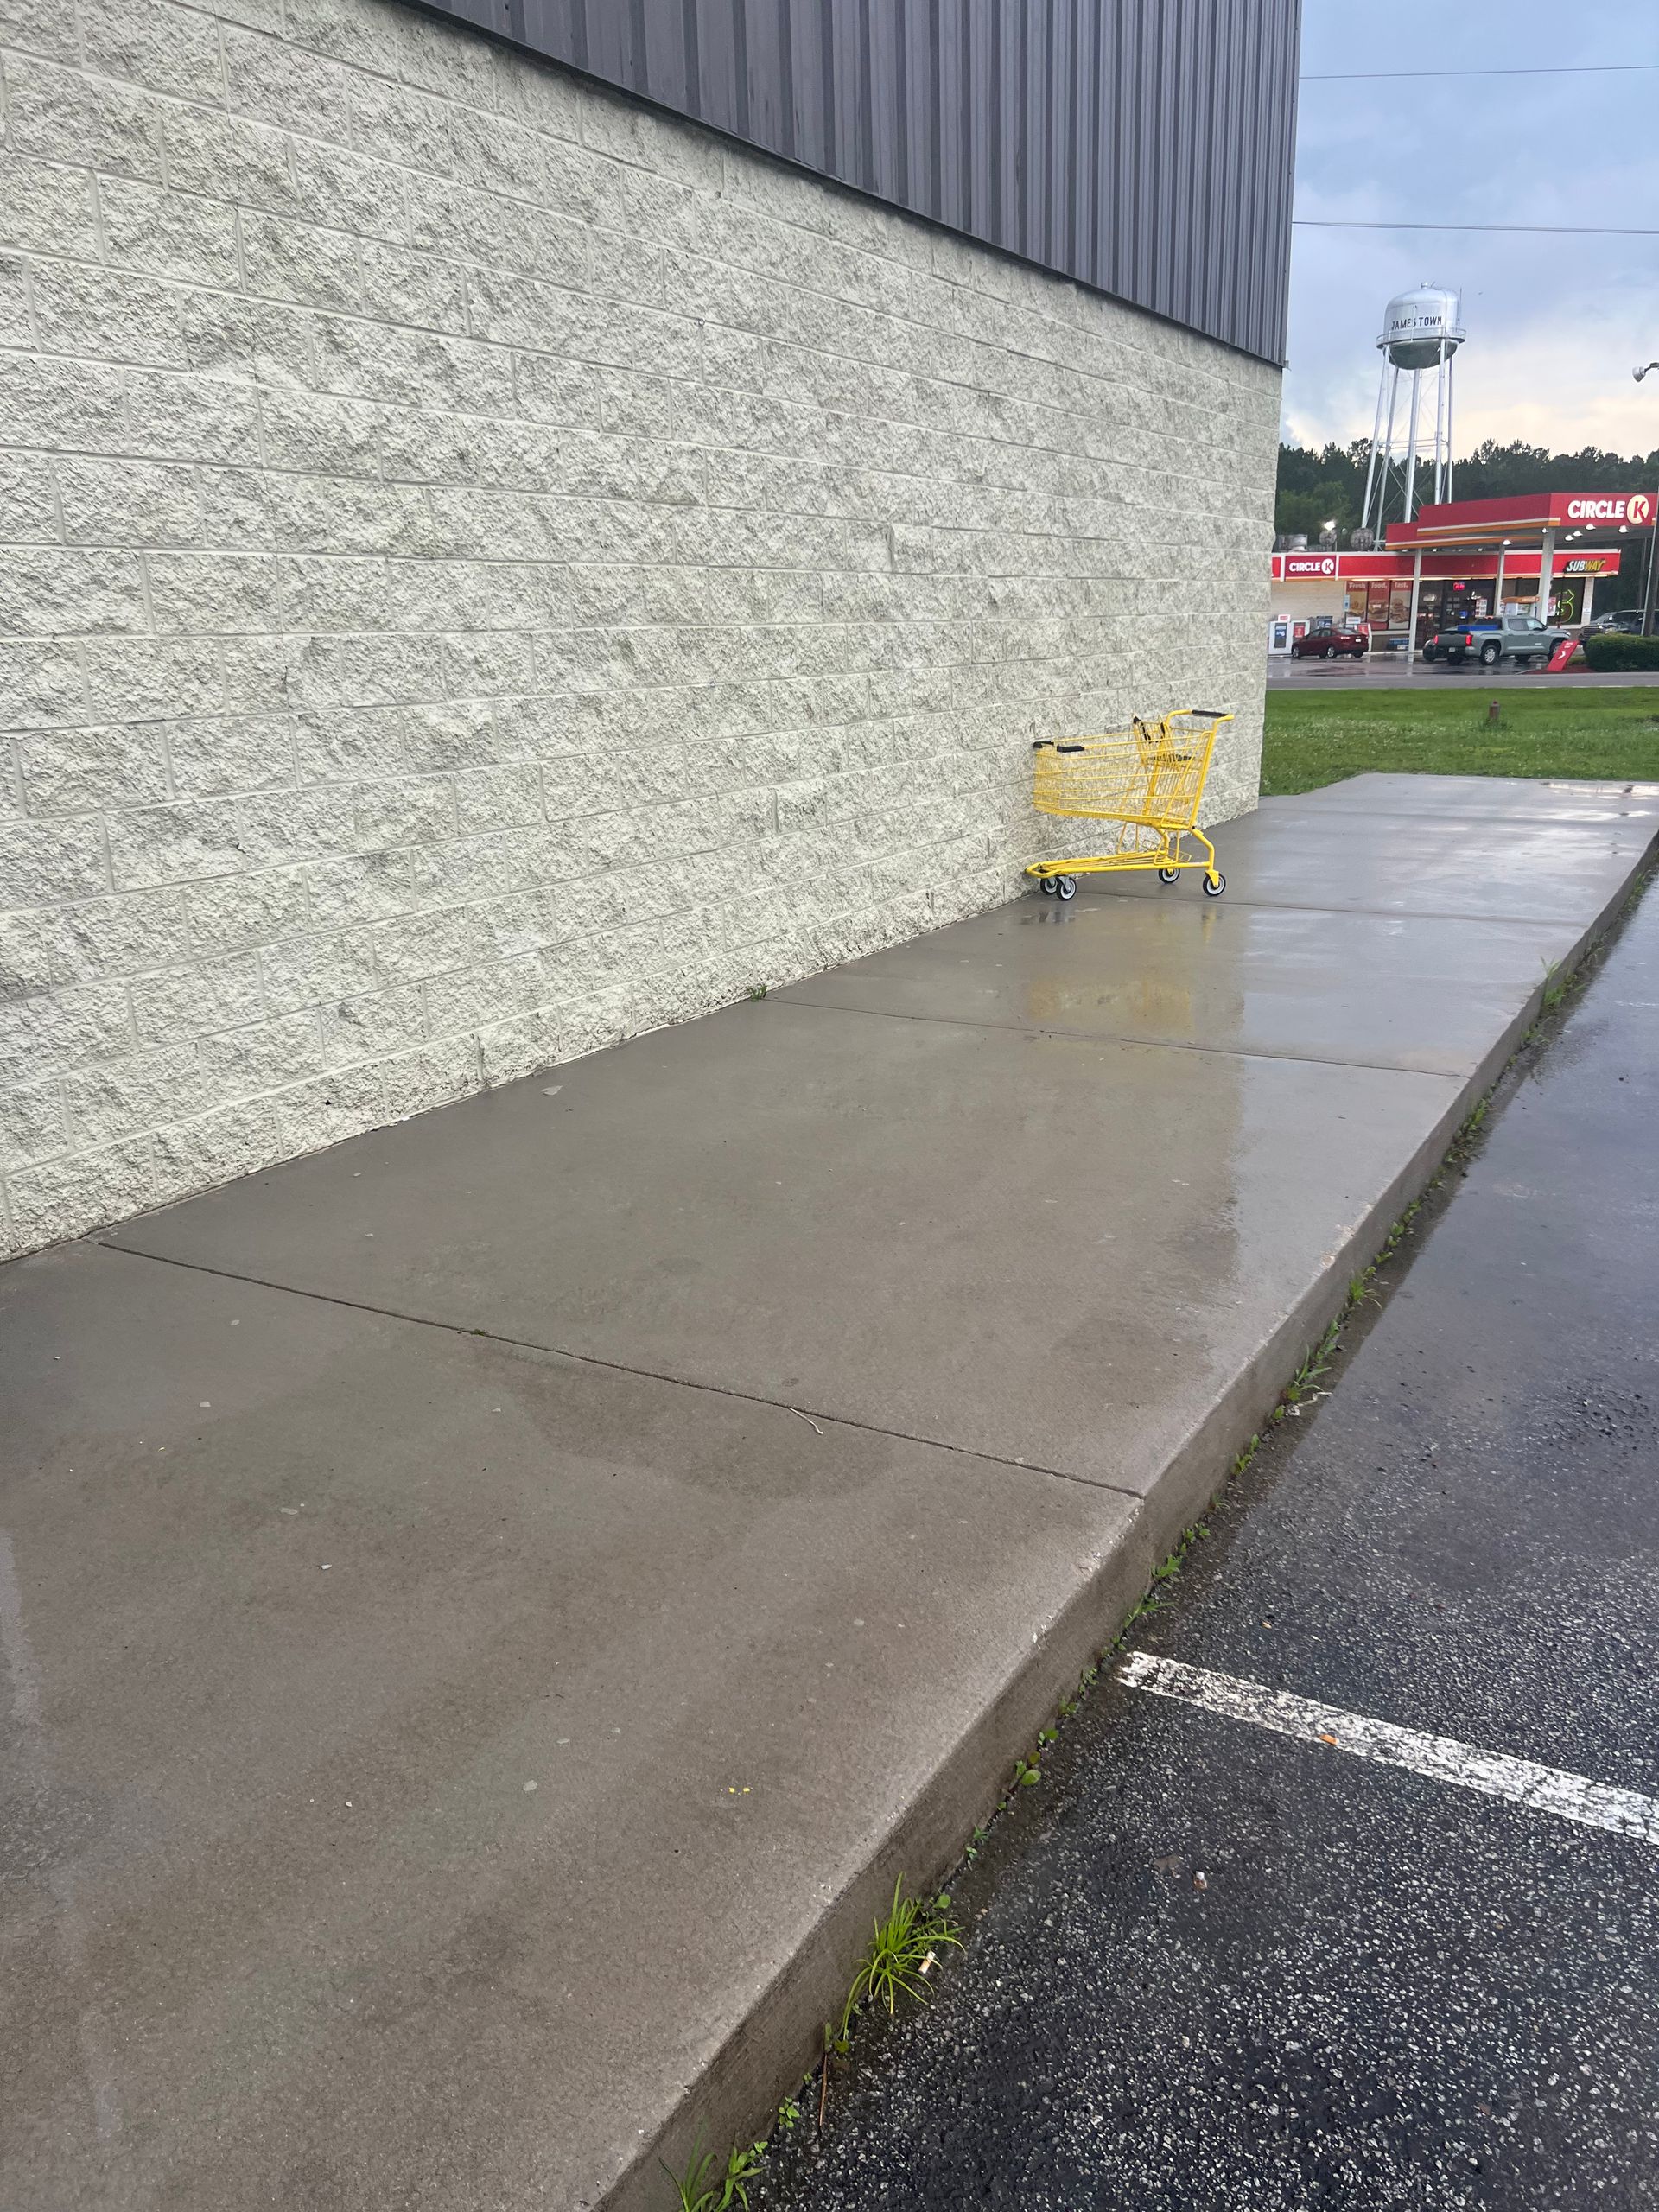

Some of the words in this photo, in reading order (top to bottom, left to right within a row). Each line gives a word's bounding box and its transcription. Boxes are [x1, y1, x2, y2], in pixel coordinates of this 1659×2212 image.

[1567, 500, 1625, 518] CIRCLE
[1289, 563, 1320, 572] CIRCLE
[1566, 559, 1605, 572] SUBWAY
